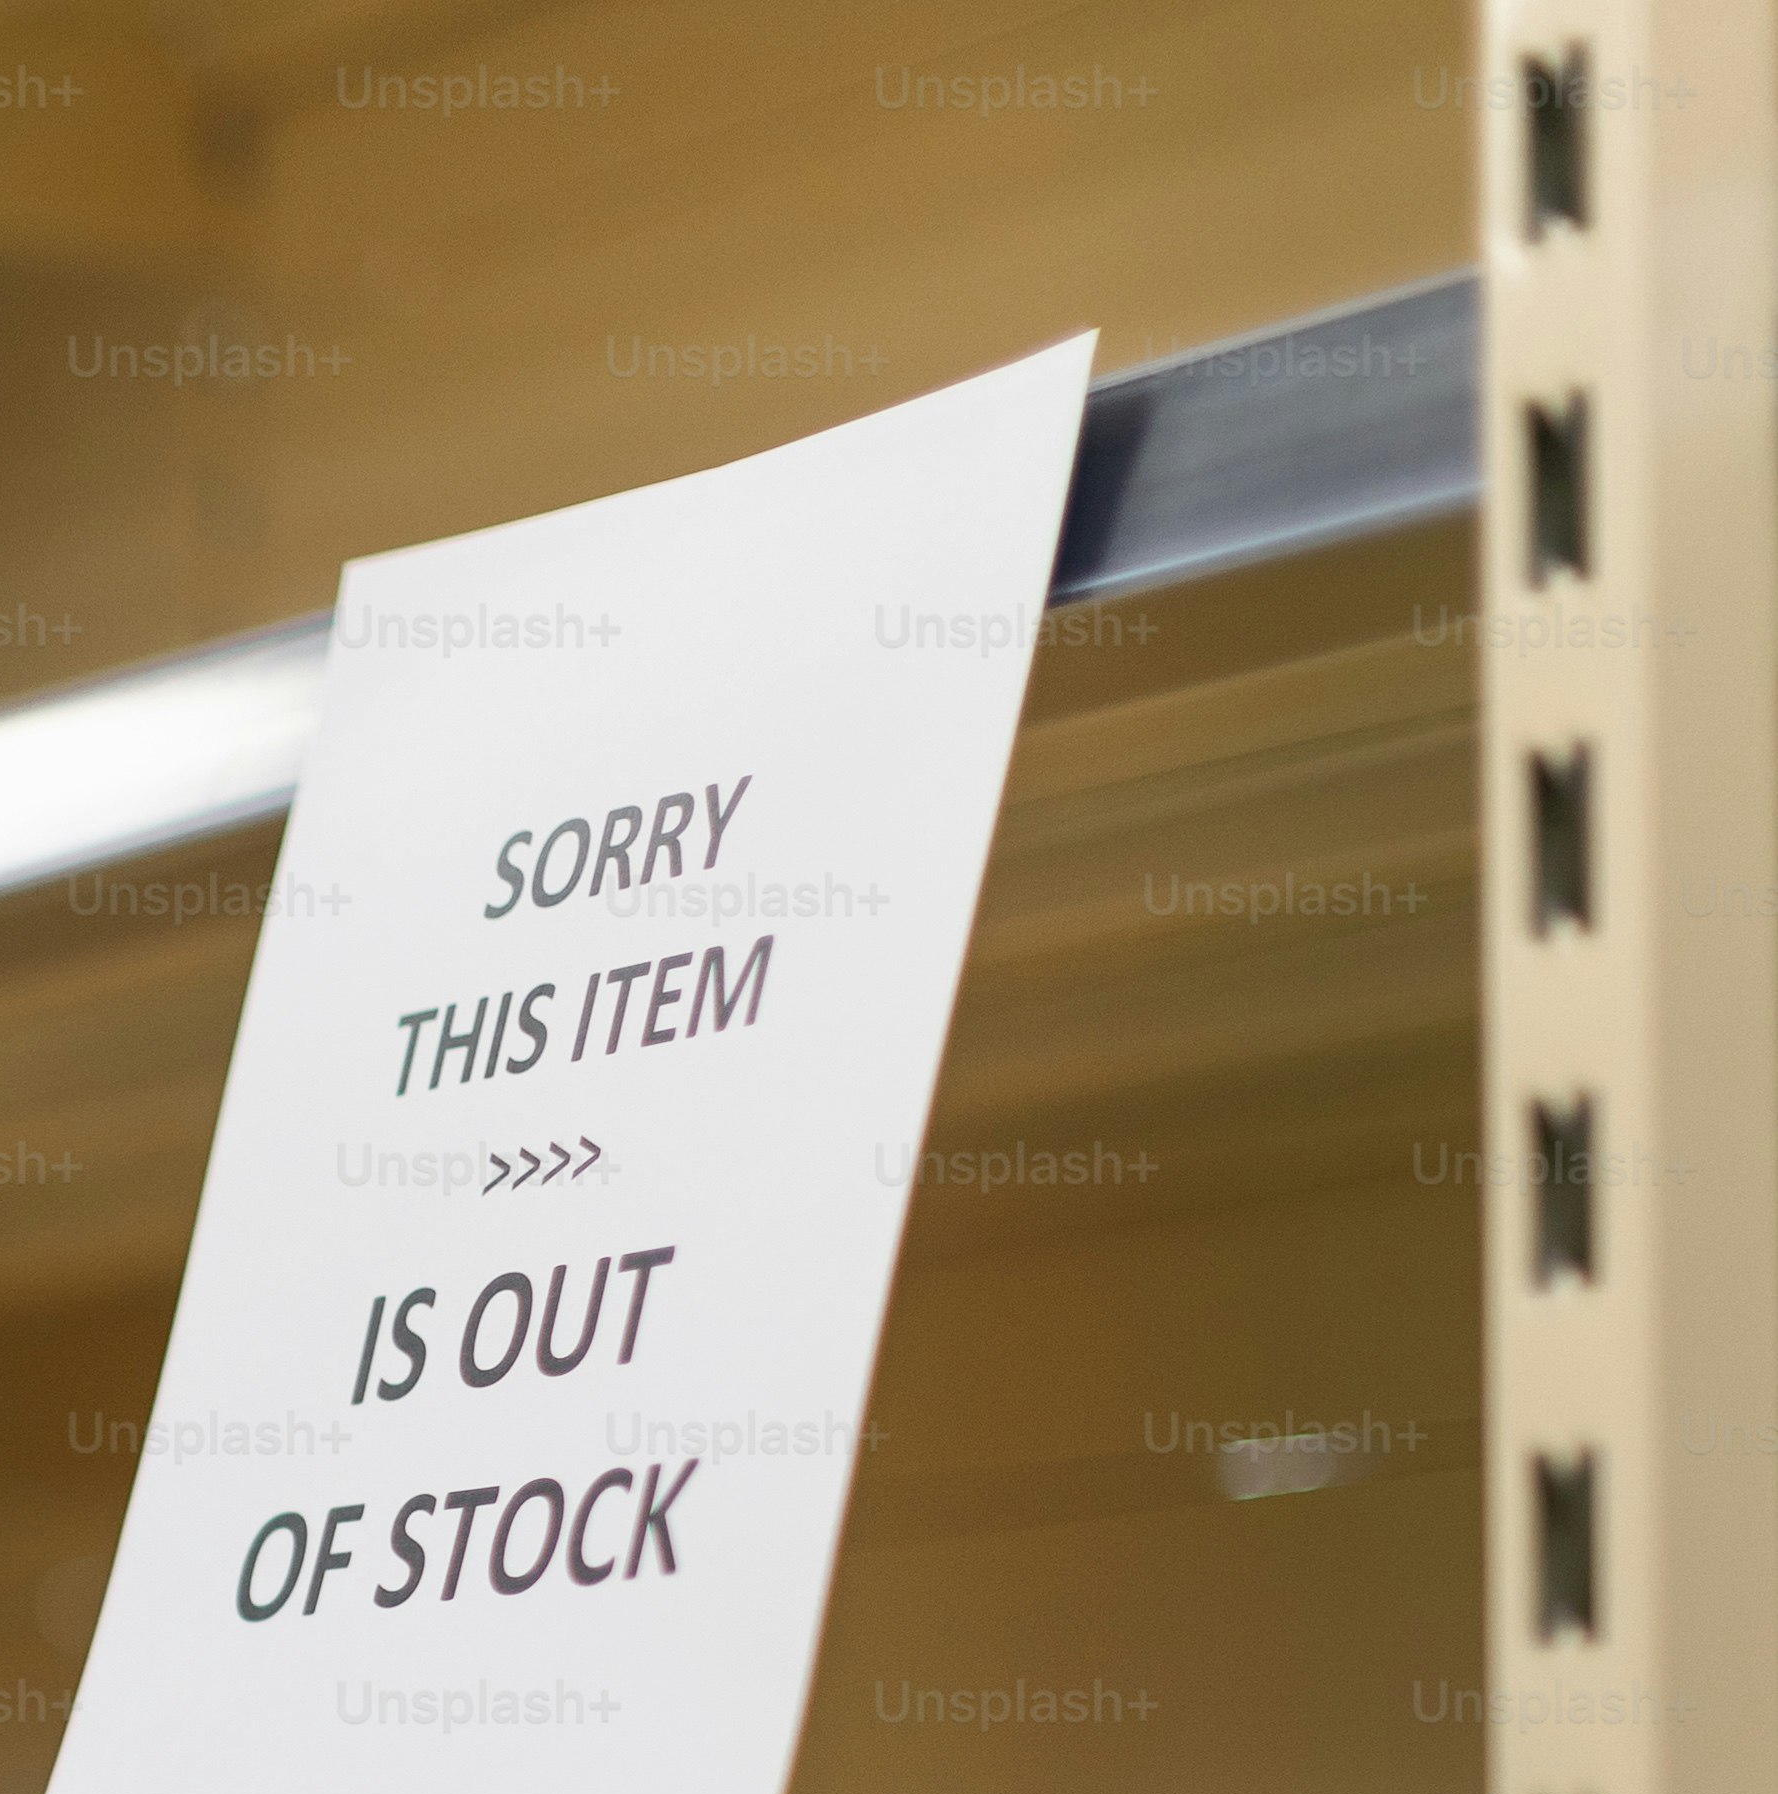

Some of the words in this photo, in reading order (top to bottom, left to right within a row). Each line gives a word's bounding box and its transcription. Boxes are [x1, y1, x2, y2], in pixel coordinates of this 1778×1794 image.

[483, 774, 753, 920] SORRY
[396, 982, 557, 1098] THIS
[570, 934, 775, 1063] ITEM
[350, 1286, 438, 1407] IS
[458, 1244, 677, 1390] OUT
[235, 1502, 367, 1624] OF
[372, 1457, 700, 1610] STOCK
